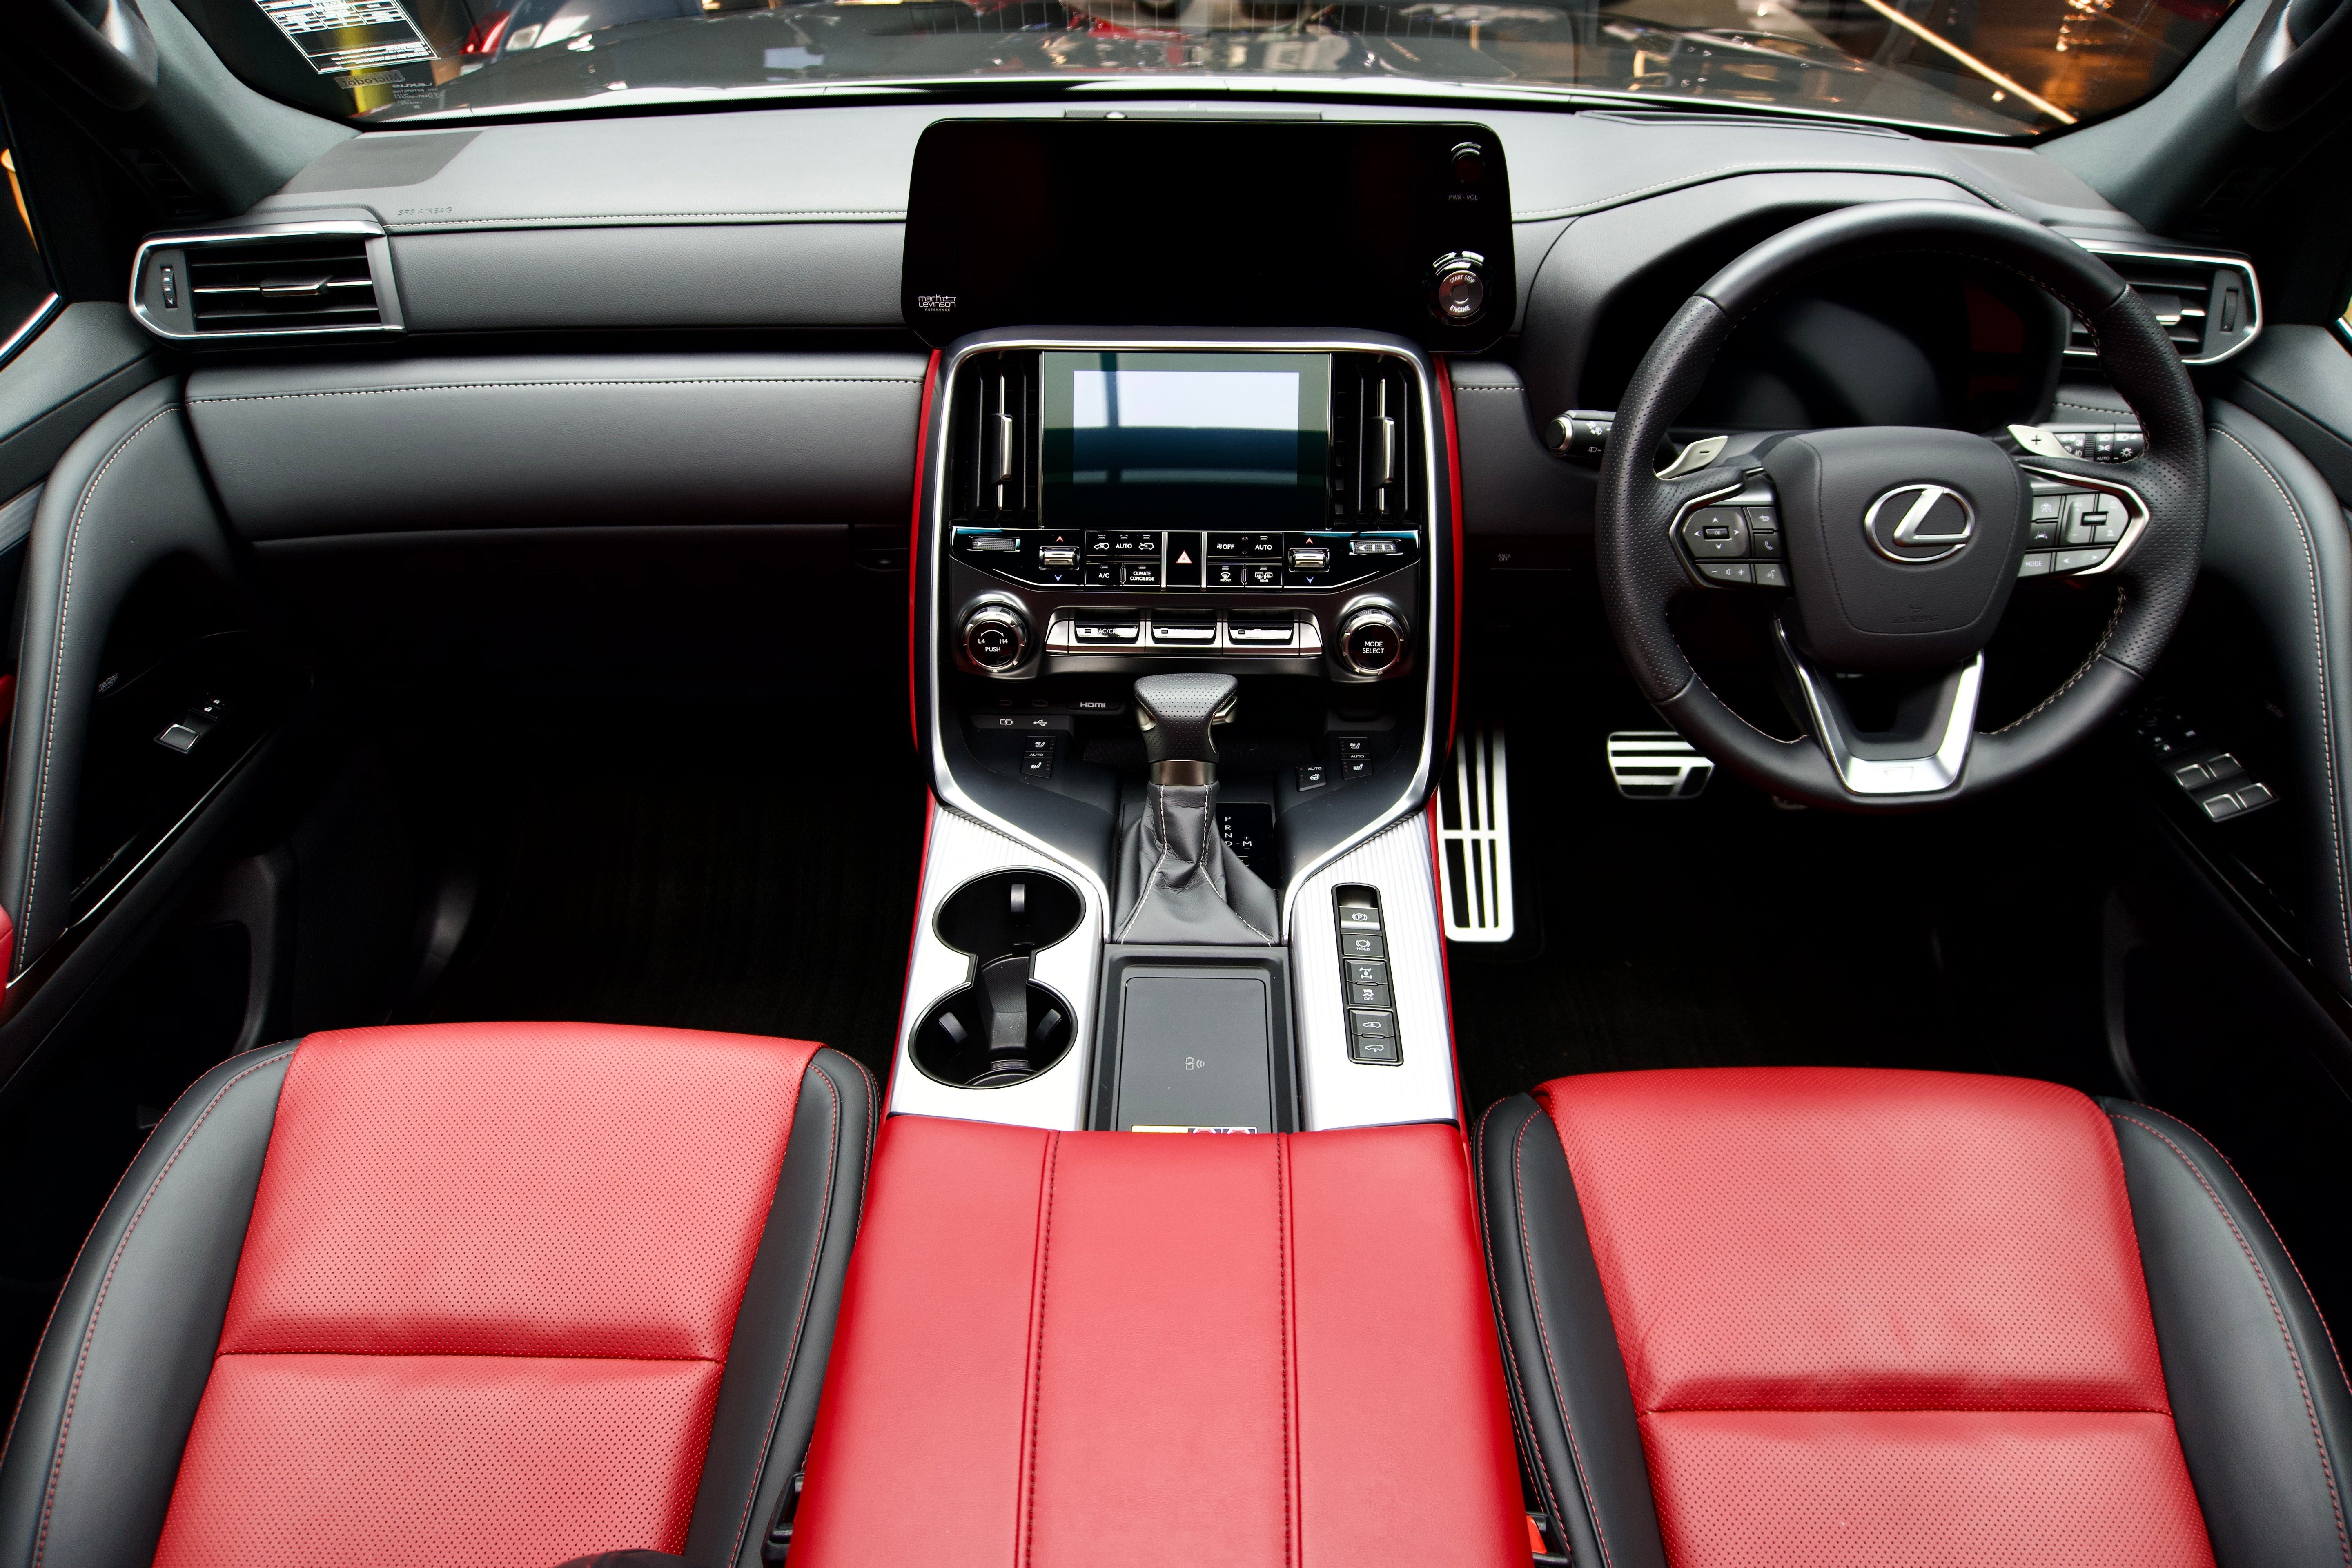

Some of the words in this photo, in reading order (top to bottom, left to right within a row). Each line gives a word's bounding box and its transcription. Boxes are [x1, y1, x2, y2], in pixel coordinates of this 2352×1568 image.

[1450, 275, 1463, 284] START
[1464, 275, 1475, 283] STOP
[1450, 305, 1470, 313] ENGINE
